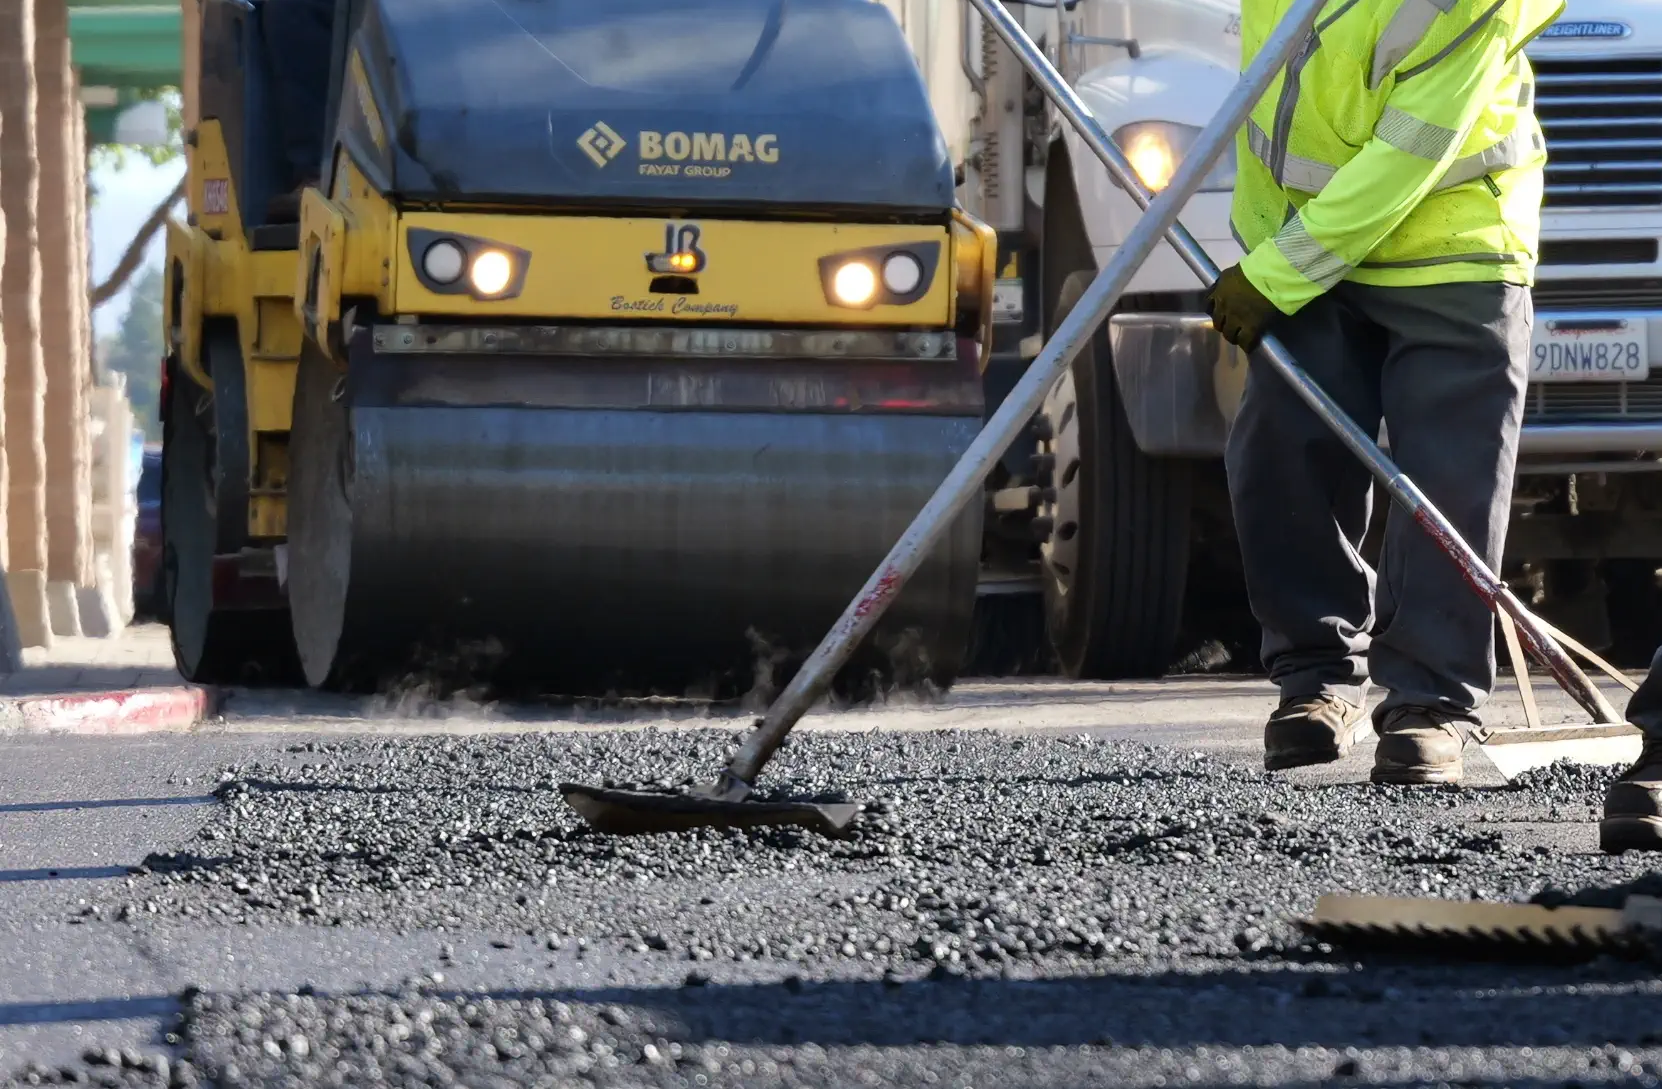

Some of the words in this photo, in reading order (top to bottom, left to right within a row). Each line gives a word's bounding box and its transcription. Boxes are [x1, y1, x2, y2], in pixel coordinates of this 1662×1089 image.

[1544, 24, 1621, 36] REIGHTLINER
[639, 130, 780, 162] BOMAG
[638, 164, 681, 176] FAYAT
[683, 165, 732, 178] GROUP
[610, 295, 665, 311] Bostick
[671, 296, 739, 318] Company
[1534, 341, 1640, 372] 9DNW828
